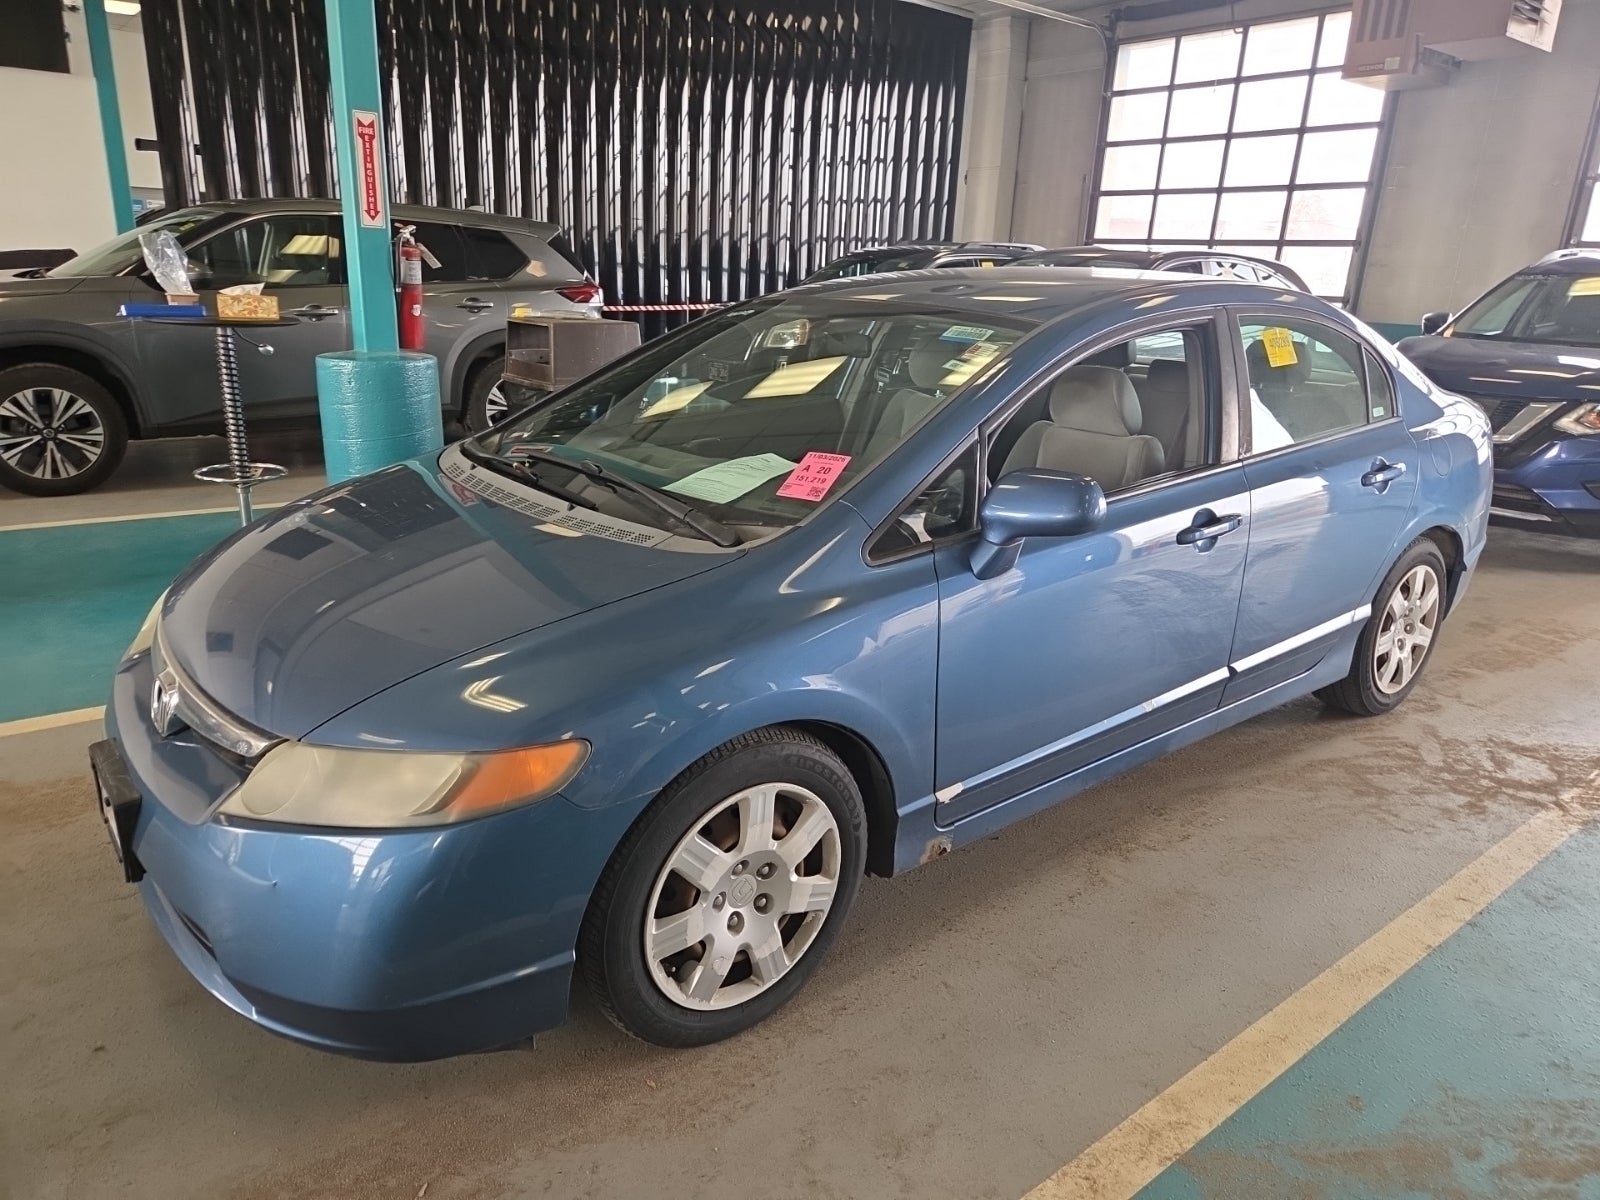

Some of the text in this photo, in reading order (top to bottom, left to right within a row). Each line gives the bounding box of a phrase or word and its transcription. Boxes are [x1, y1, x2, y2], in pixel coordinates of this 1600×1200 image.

[358, 126, 375, 135] FIRE
[364, 135, 376, 216] EXTINGUISHER
[816, 466, 832, 474] 20
